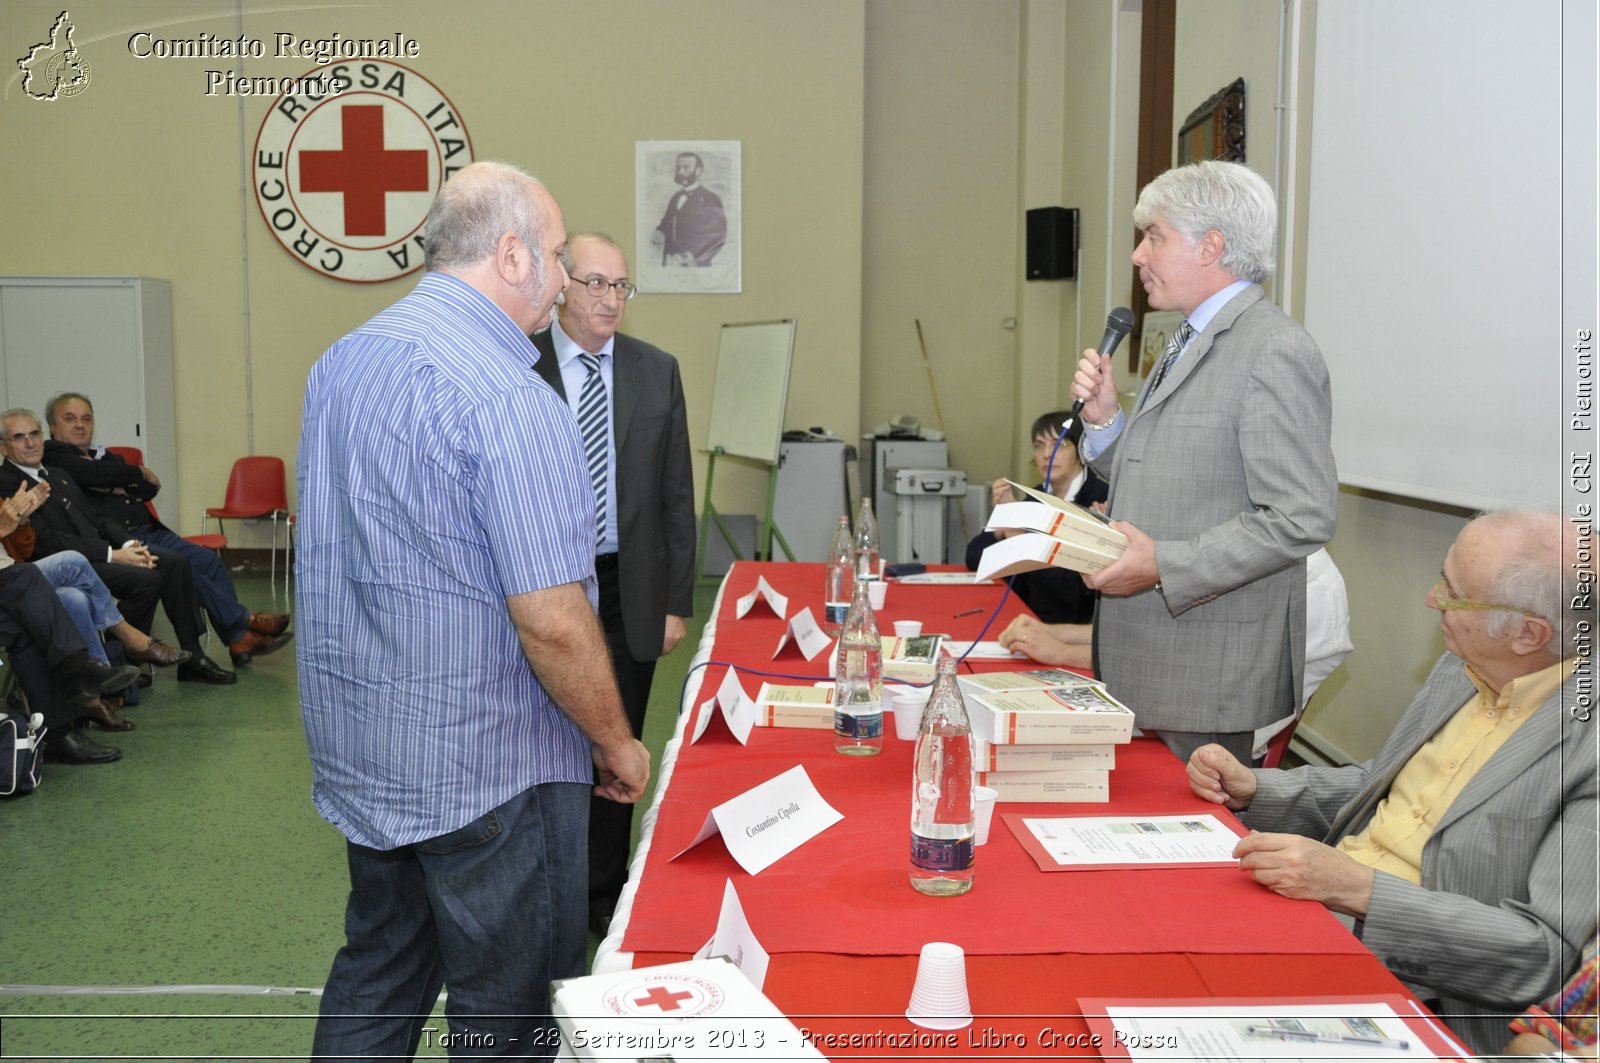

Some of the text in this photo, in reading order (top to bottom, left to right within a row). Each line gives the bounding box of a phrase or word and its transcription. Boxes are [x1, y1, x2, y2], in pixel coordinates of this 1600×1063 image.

[278, 63, 406, 124] ROSSA
[258, 150, 344, 272] CROCE
[745, 802, 800, 838] Costantino Cipolla
